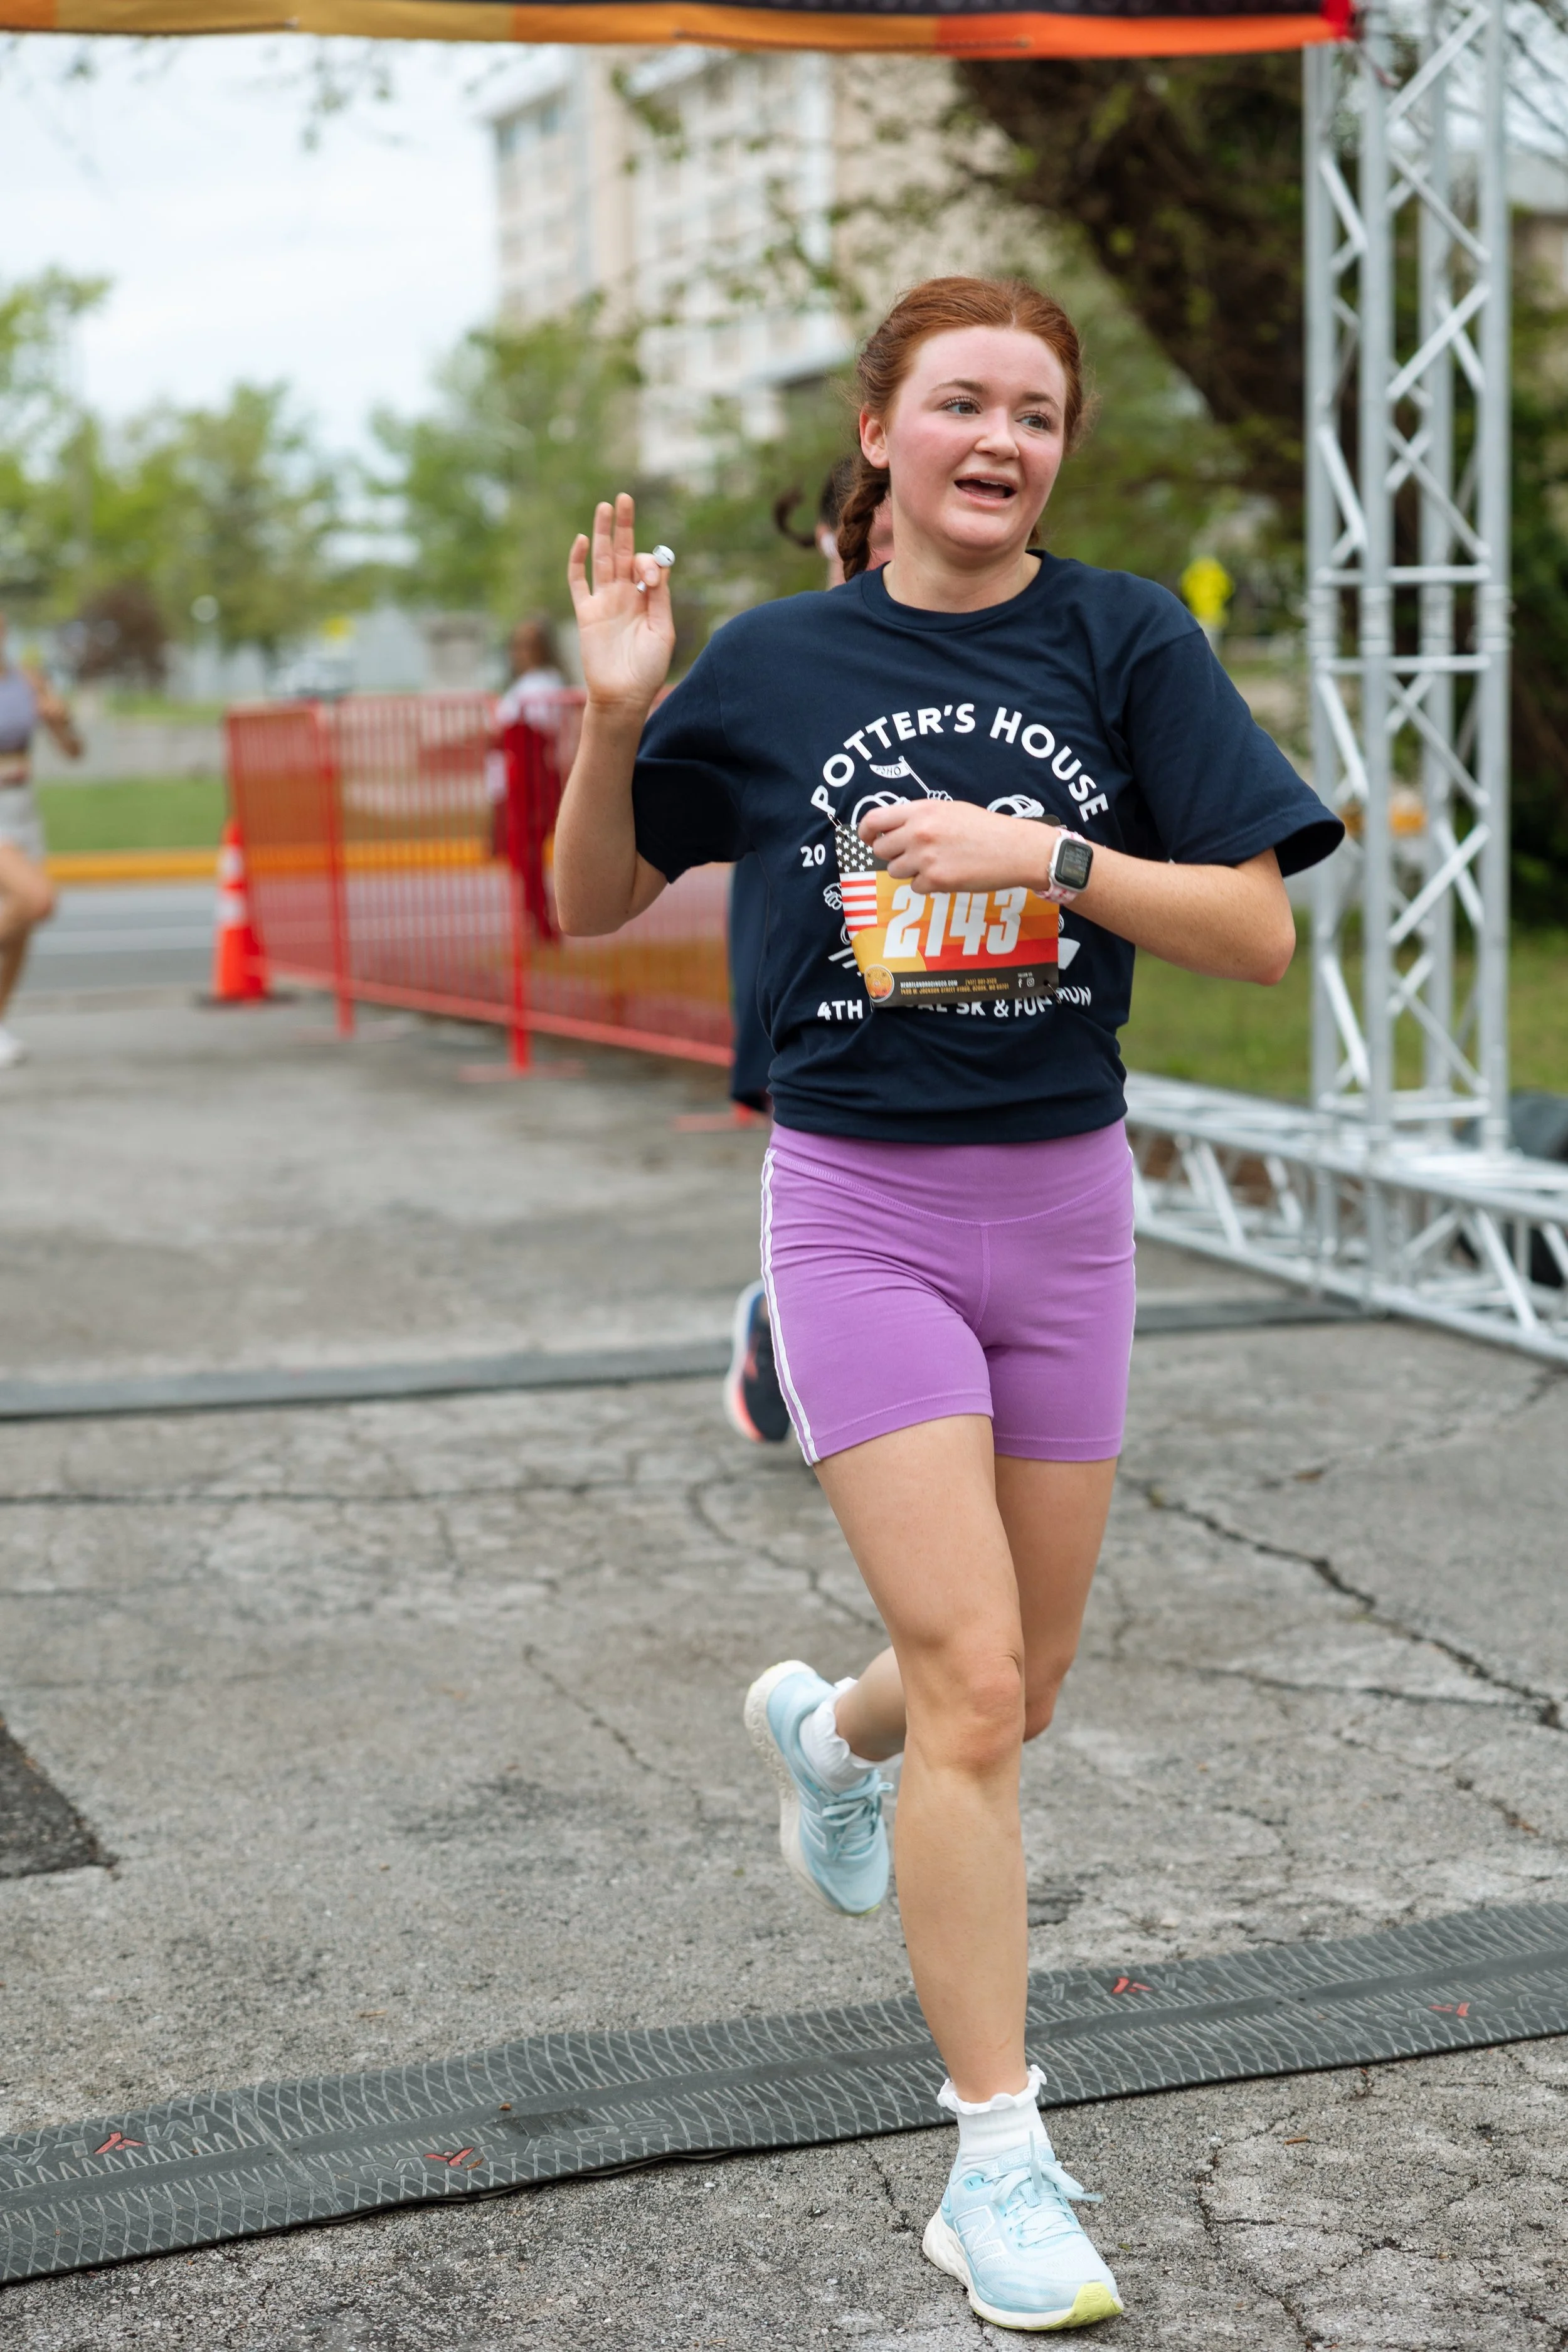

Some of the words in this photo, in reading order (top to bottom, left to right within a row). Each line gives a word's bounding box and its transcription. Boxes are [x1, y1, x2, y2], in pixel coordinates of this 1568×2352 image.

[810, 703, 975, 815] POTTER'S
[989, 706, 1109, 822] HOUSE
[800, 844, 826, 867] 20
[883, 884, 1028, 958] 2143
[817, 999, 862, 1020] 4TH
[993, 999, 1009, 1017] &
